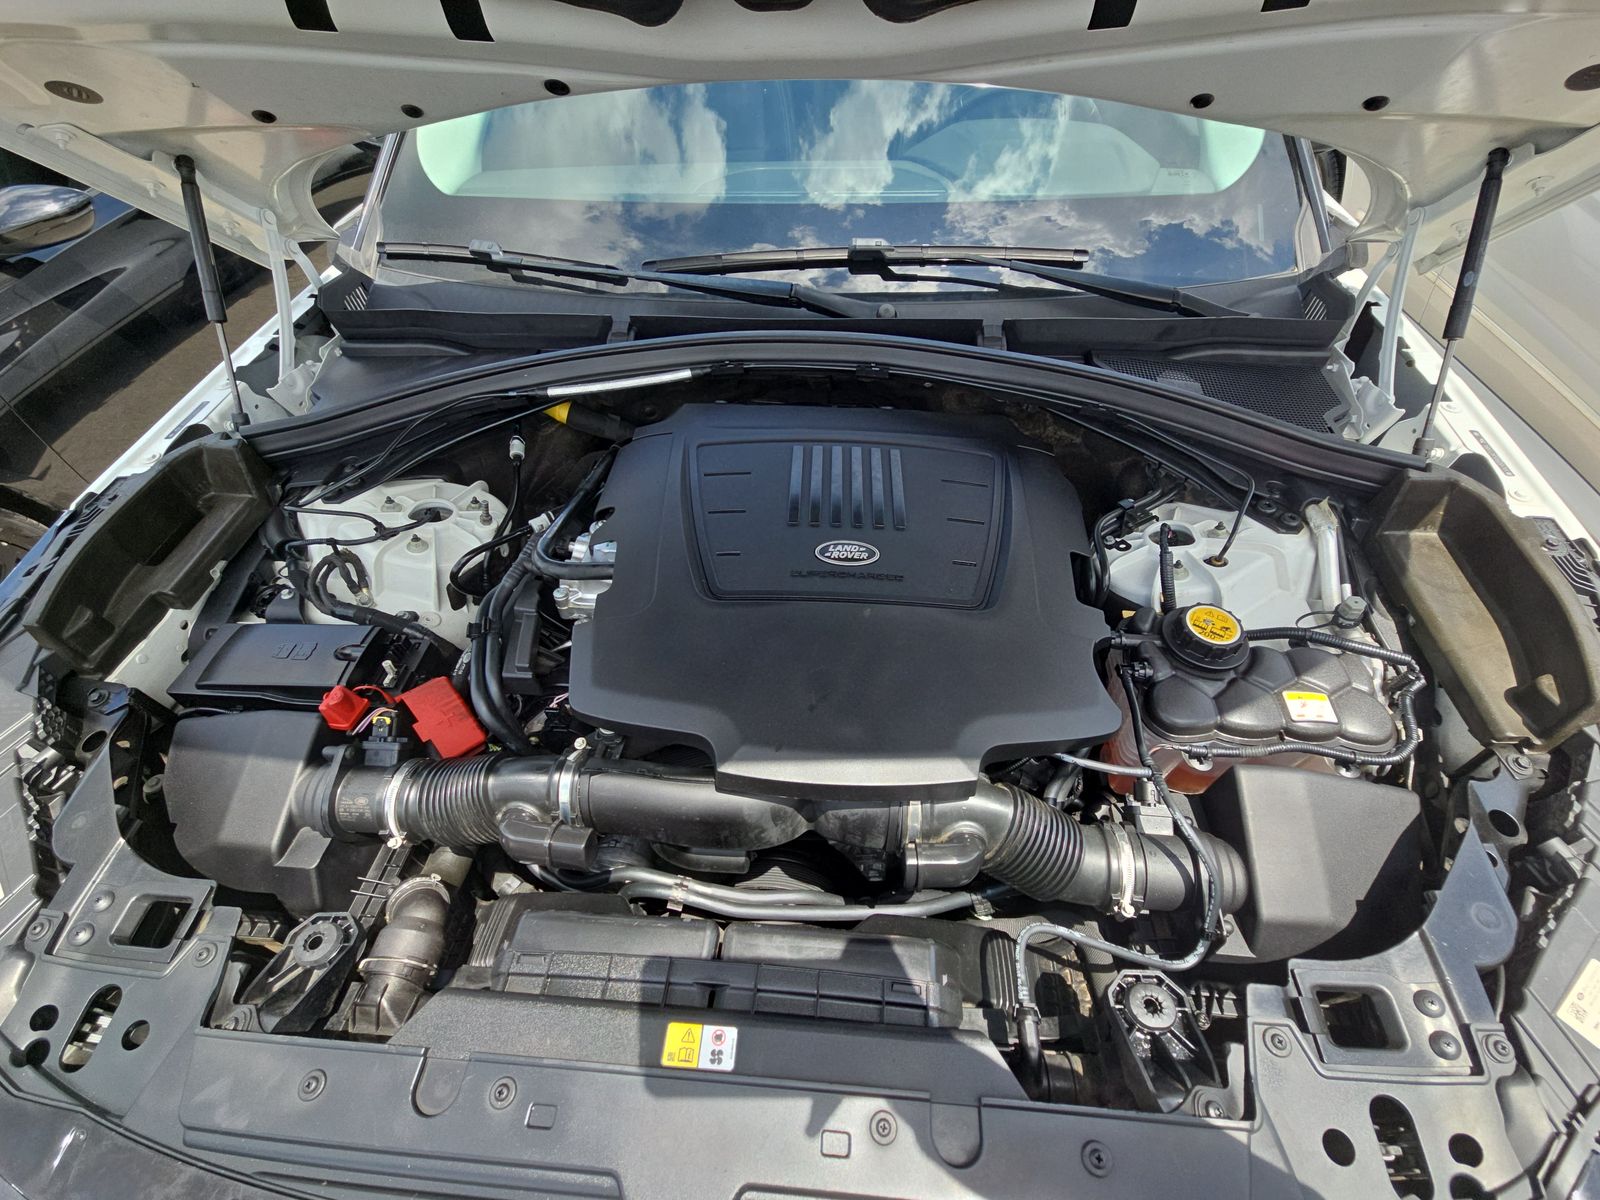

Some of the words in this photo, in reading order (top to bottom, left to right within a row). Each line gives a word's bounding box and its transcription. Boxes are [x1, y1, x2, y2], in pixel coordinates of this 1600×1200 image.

[828, 544, 858, 552] LAND
[830, 551, 869, 560] ROVER
[790, 570, 904, 582] SUPERCHARGED
